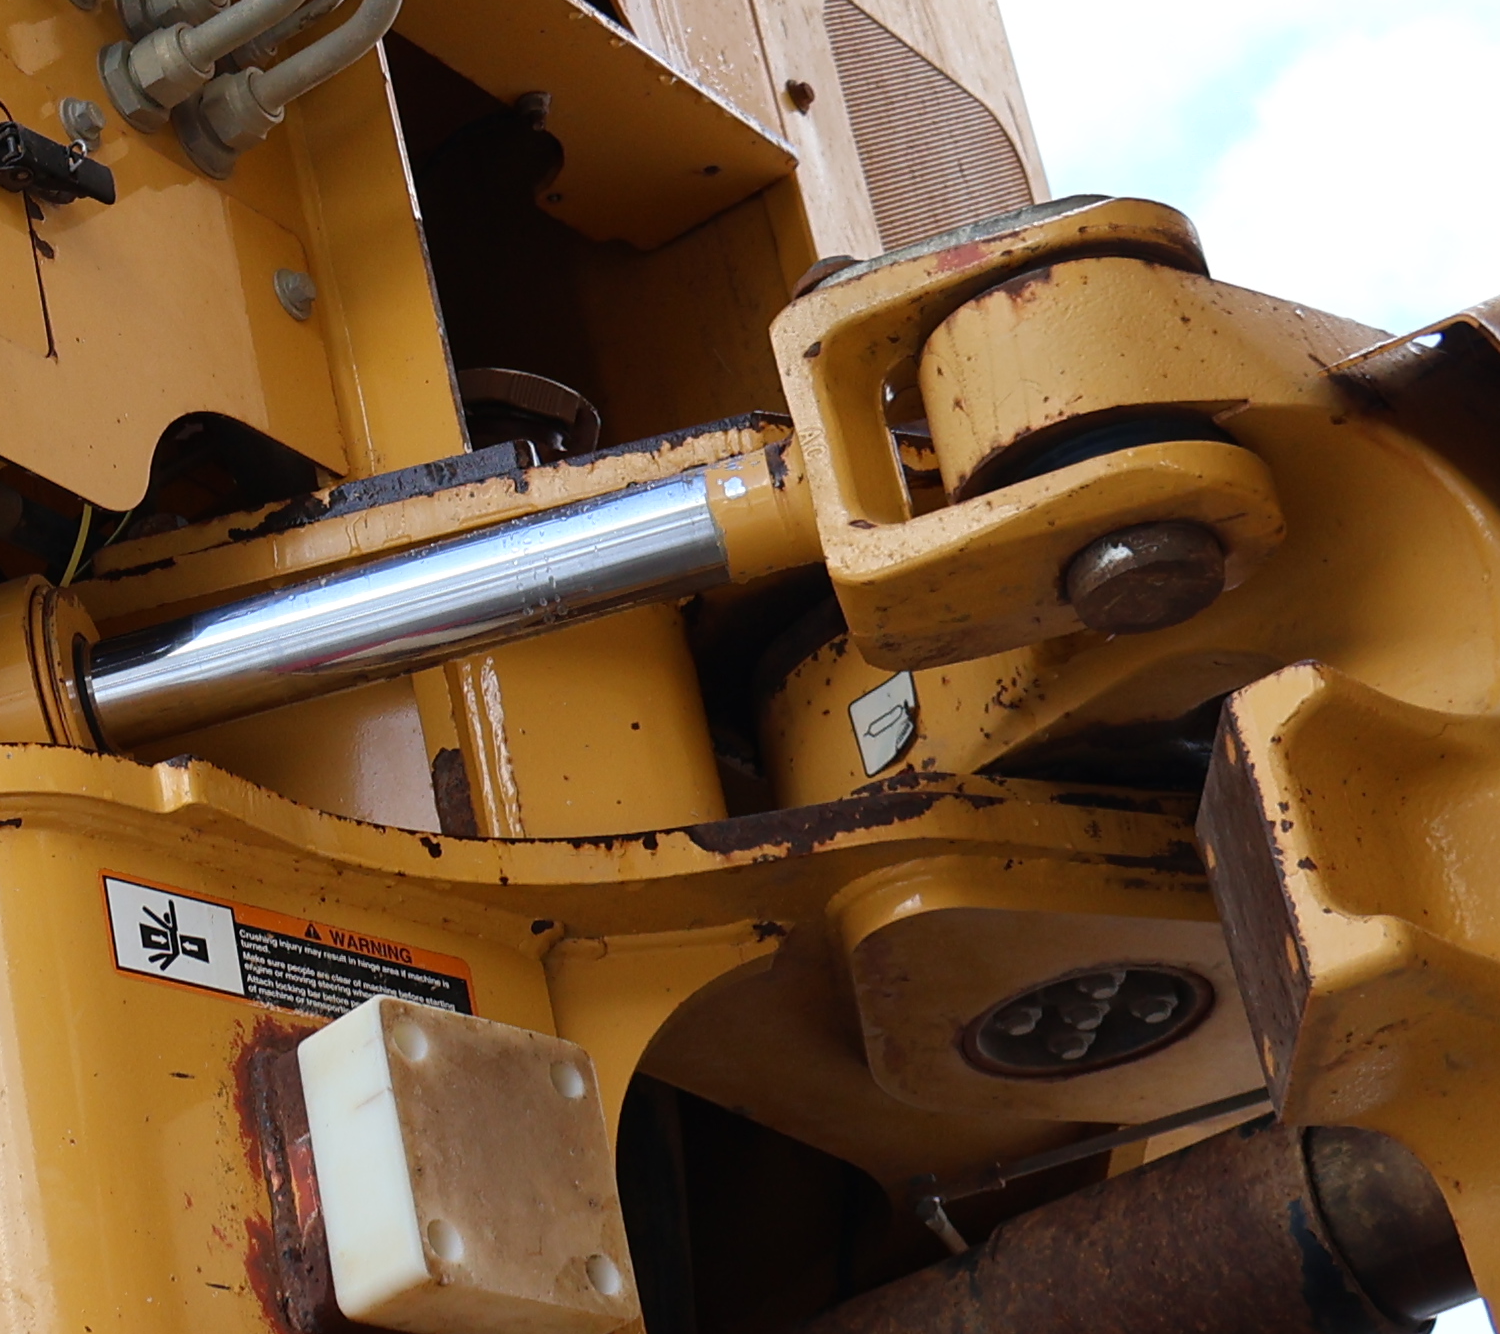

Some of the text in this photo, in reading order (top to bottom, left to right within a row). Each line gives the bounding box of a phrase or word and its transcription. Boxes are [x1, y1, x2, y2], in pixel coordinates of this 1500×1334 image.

[238, 927, 450, 989] Crushing injury may result in hinge area if machine is
[240, 938, 271, 955] turned.
[329, 928, 413, 964] WARNING
[242, 949, 455, 1013] Make sure people are clear of machine before starting
[243, 960, 273, 978] engine
[273, 968, 284, 980] or
[284, 969, 317, 988] moving
[317, 976, 351, 997] steering
[245, 972, 274, 988] Attach
[274, 979, 307, 998] locking
[306, 987, 321, 1000] bar
[321, 990, 349, 1007] before
[247, 982, 257, 994] of
[257, 985, 294, 1003] machine
[294, 993, 305, 1005] or
